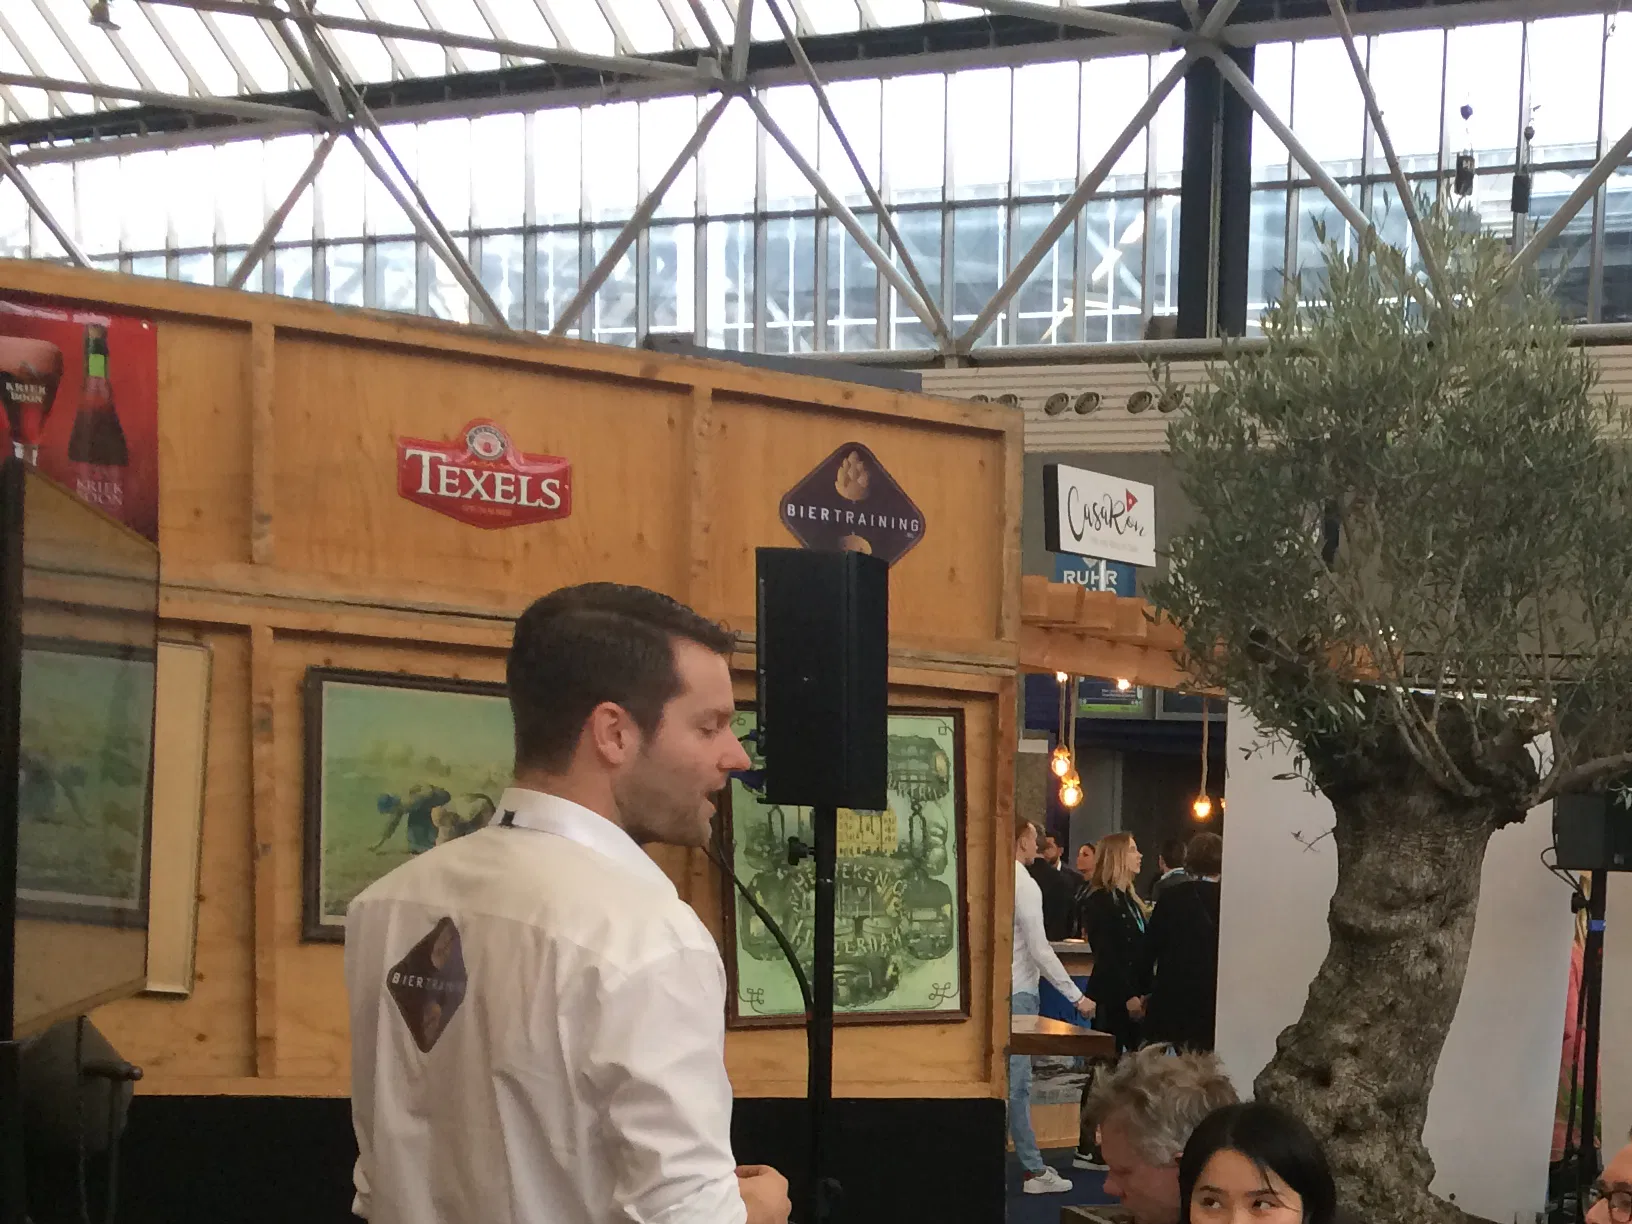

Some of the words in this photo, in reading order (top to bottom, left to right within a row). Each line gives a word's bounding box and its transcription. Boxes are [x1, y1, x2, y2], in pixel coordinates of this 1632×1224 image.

[5, 381, 47, 395] KRIEK
[76, 478, 123, 494] KRIEK
[405, 448, 561, 509] TEXELS
[787, 503, 919, 532] BIERTRAINING
